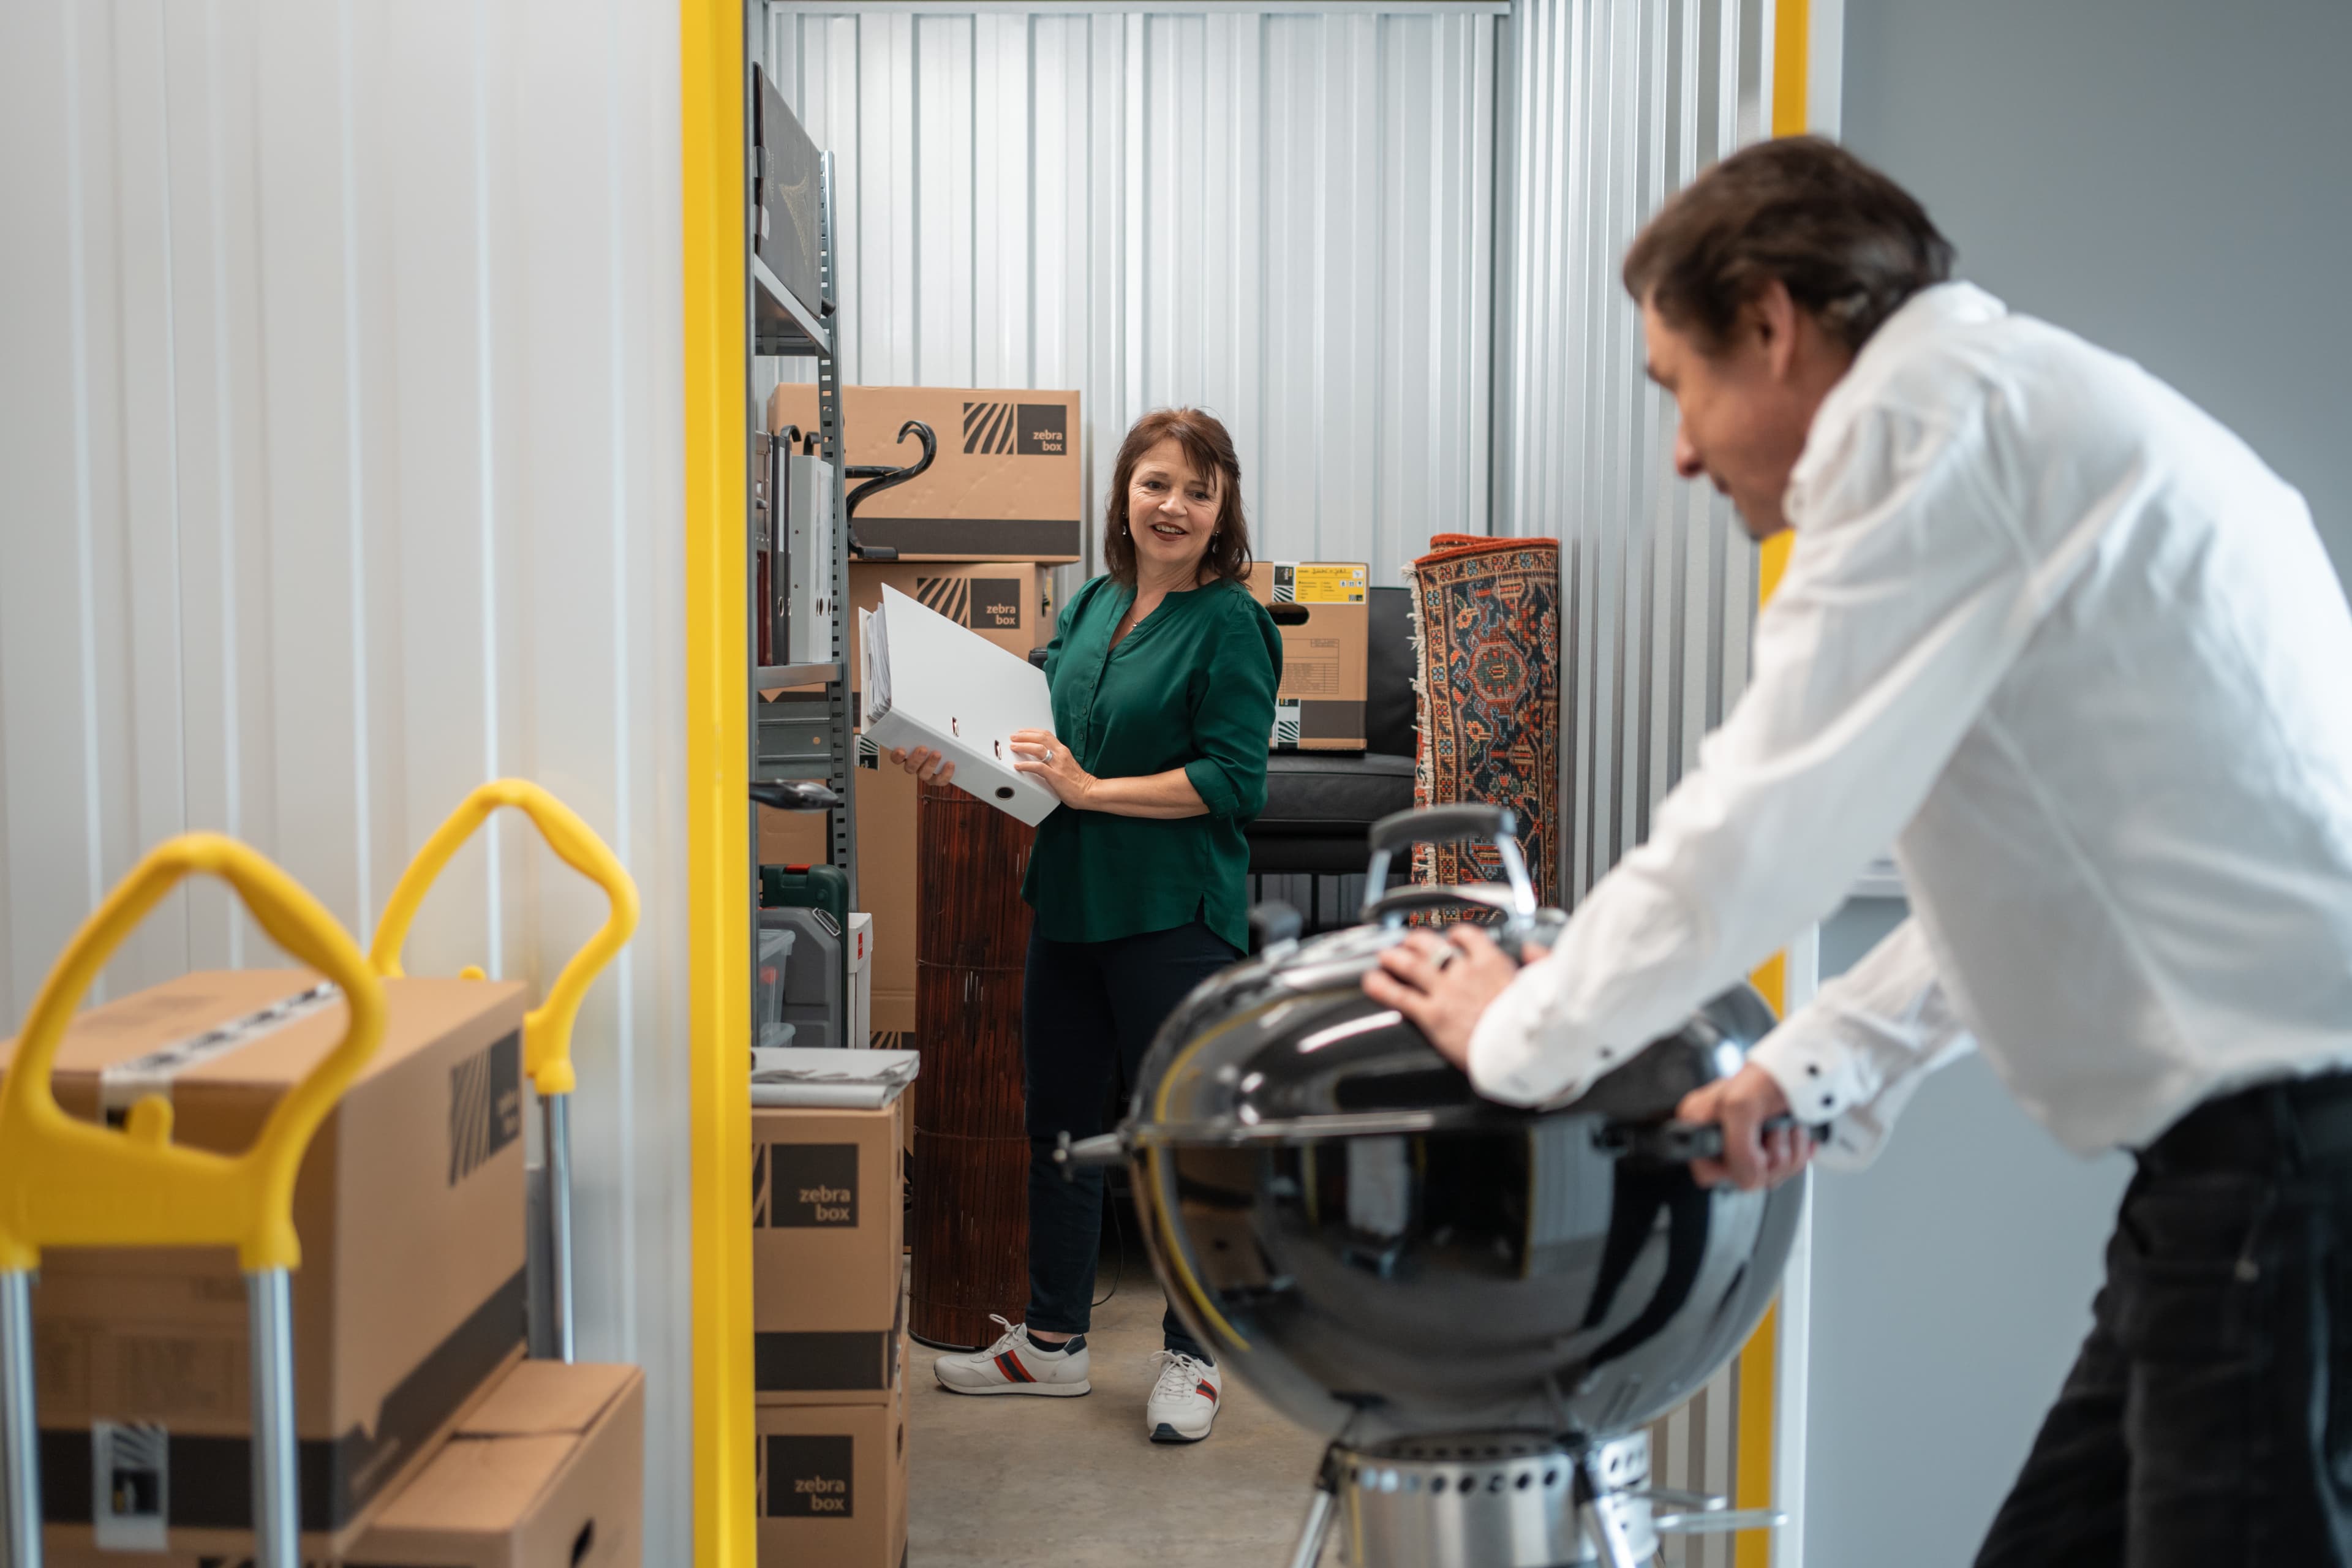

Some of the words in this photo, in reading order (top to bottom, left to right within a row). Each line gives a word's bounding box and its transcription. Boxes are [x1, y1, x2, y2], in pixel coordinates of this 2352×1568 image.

[1033, 429, 1062, 440] zebra
[1042, 441, 1062, 451] box
[986, 603, 1016, 614] zebra
[995, 615, 1016, 625] box
[799, 1185, 851, 1203] zebra
[816, 1204, 850, 1221] box
[794, 1475, 845, 1493] zebra
[811, 1494, 845, 1511] box
